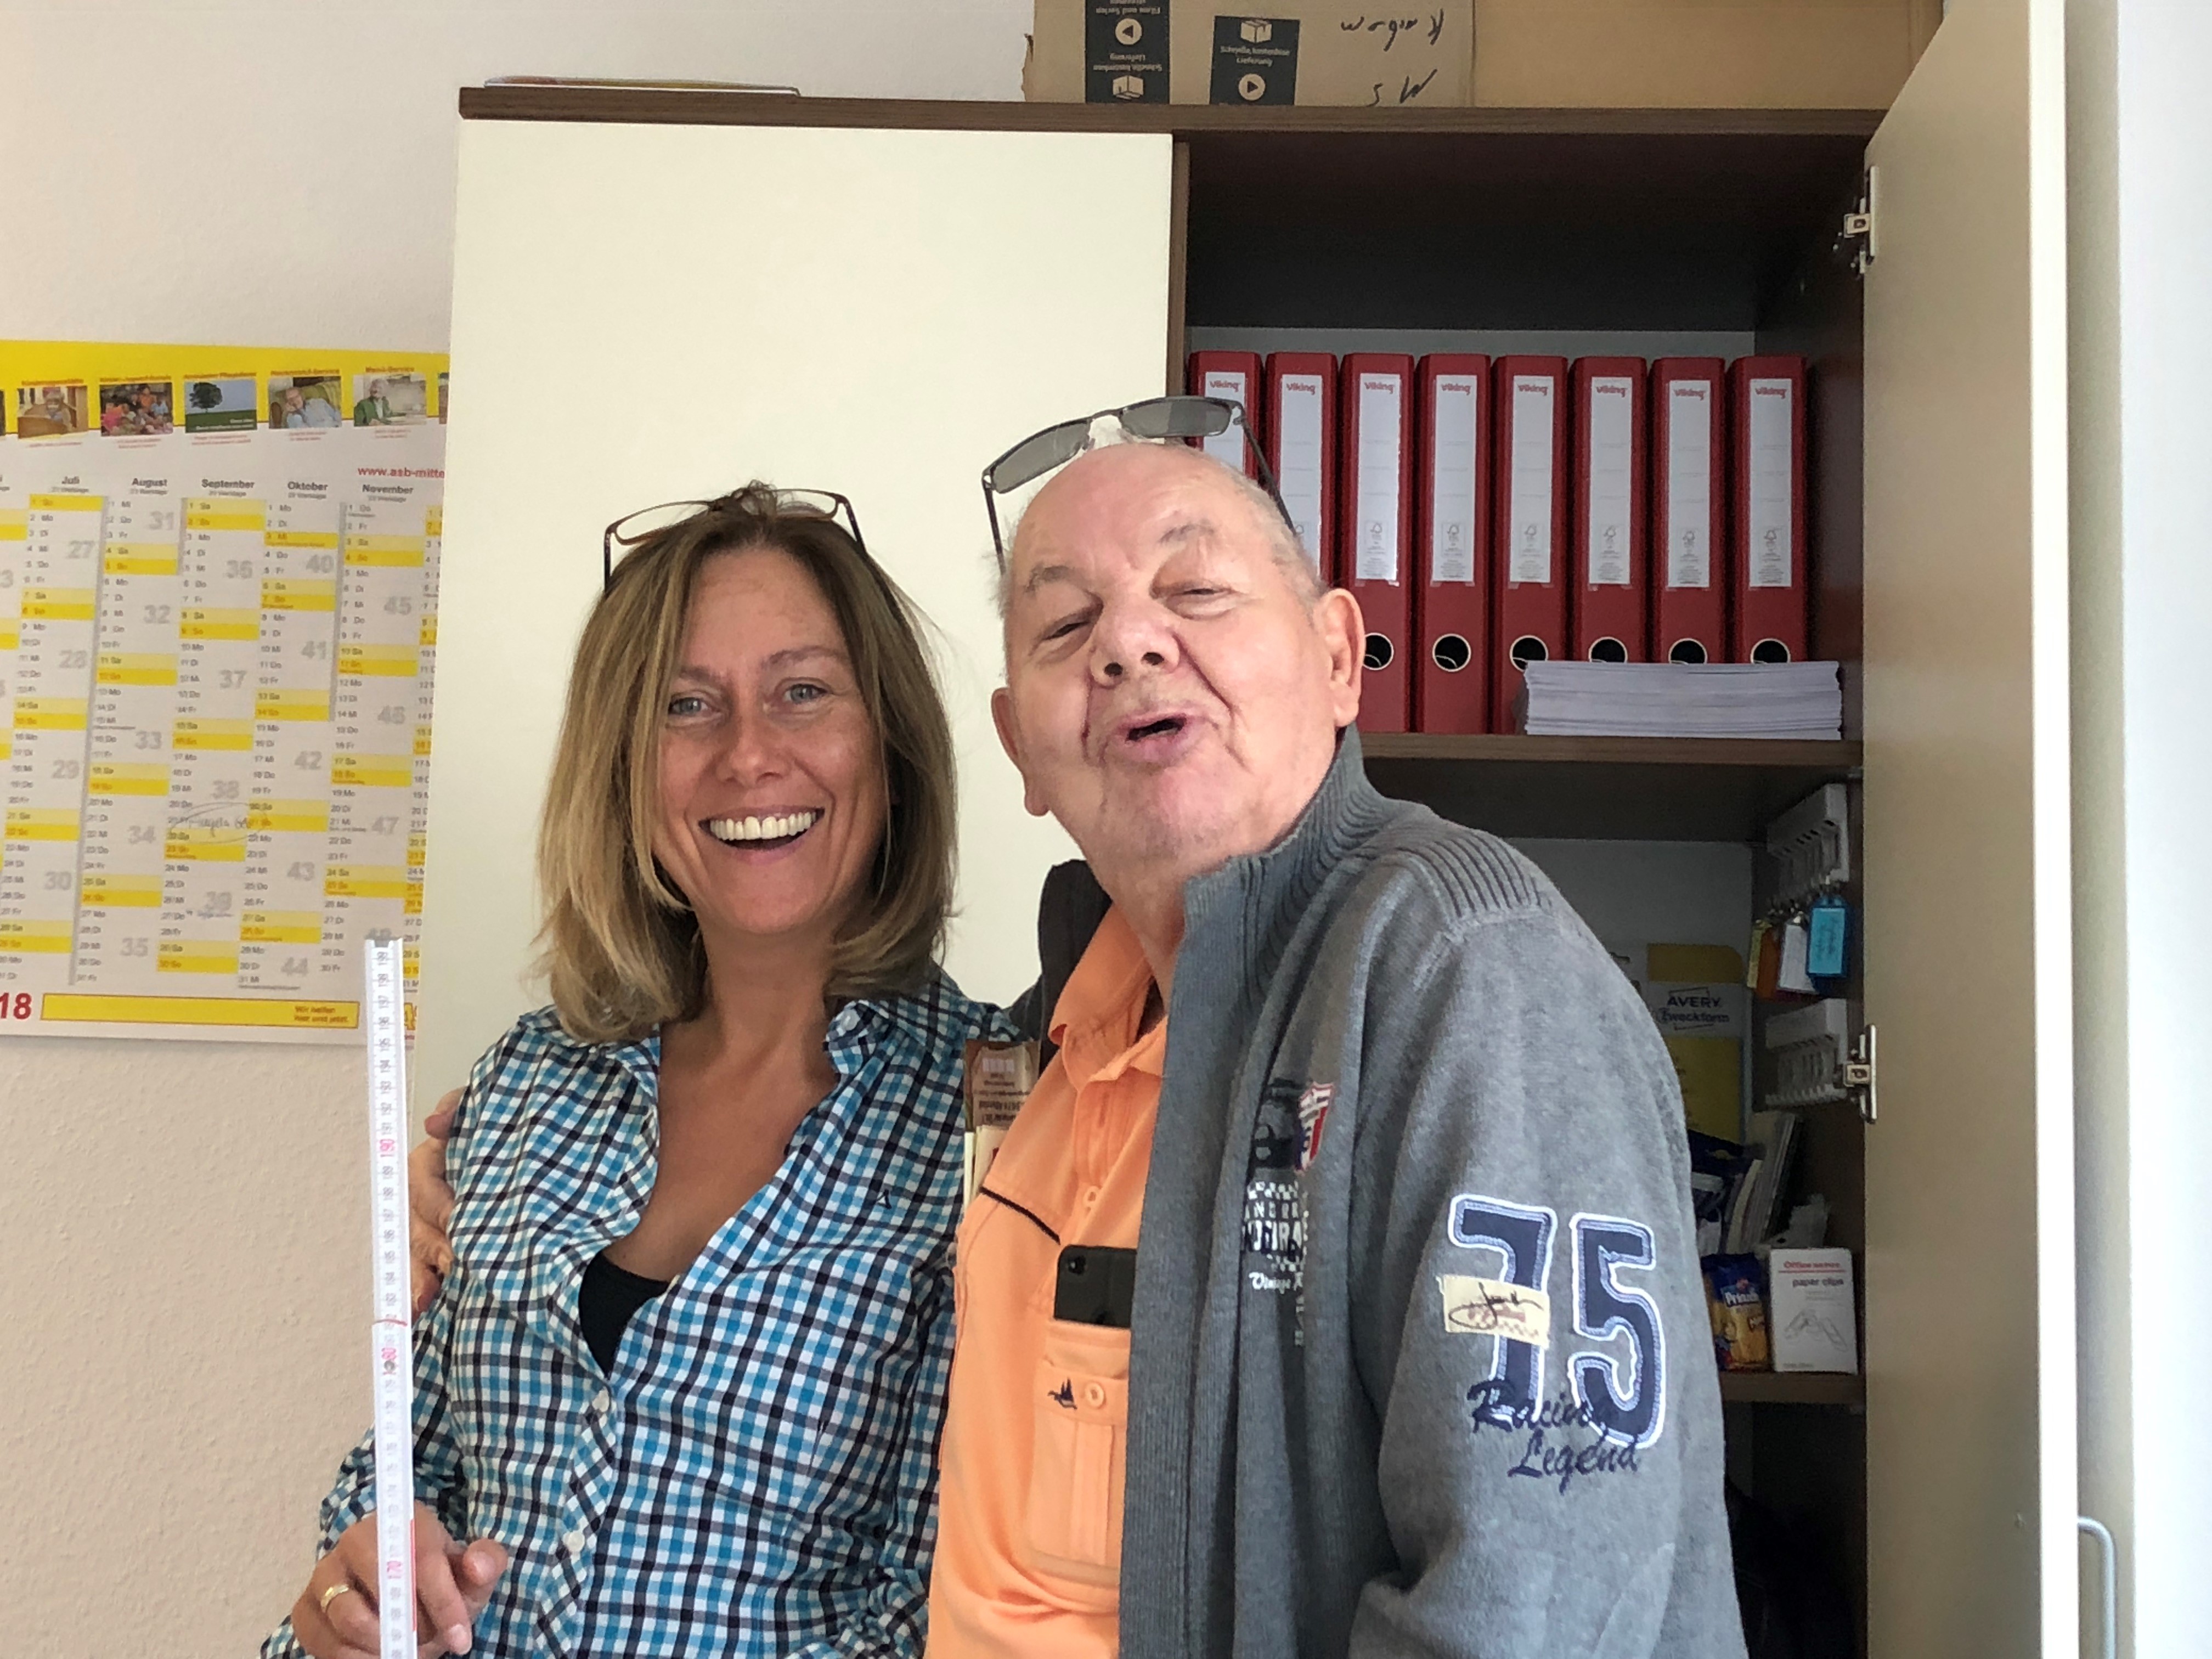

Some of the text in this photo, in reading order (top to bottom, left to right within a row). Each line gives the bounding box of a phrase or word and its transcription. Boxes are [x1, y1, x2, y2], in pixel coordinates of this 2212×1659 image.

[62, 476, 80, 484] Juli
[132, 478, 167, 488] August
[201, 479, 255, 489] September
[287, 481, 328, 491] Oktober
[362, 484, 413, 494] November
[148, 511, 174, 530] 31
[66, 540, 95, 559] 27
[227, 560, 253, 578] 36
[306, 555, 334, 573] 40
[144, 605, 171, 624] 32
[384, 596, 411, 615] 45
[302, 641, 326, 659] 41
[219, 670, 246, 688] 37
[377, 706, 405, 724] 46
[135, 731, 162, 749] 33
[294, 751, 322, 769] 42
[372, 816, 399, 834] 47
[127, 825, 155, 844] 34
[287, 861, 315, 881] 43
[44, 871, 72, 890] 30
[120, 938, 148, 957] 35
[281, 957, 308, 975] 44
[1667, 996, 1721, 1008] AVERY
[1792, 1278, 1844, 1288] paper clips
[1448, 1193, 1666, 1449] 75
[1507, 1426, 1639, 1496] Legend
